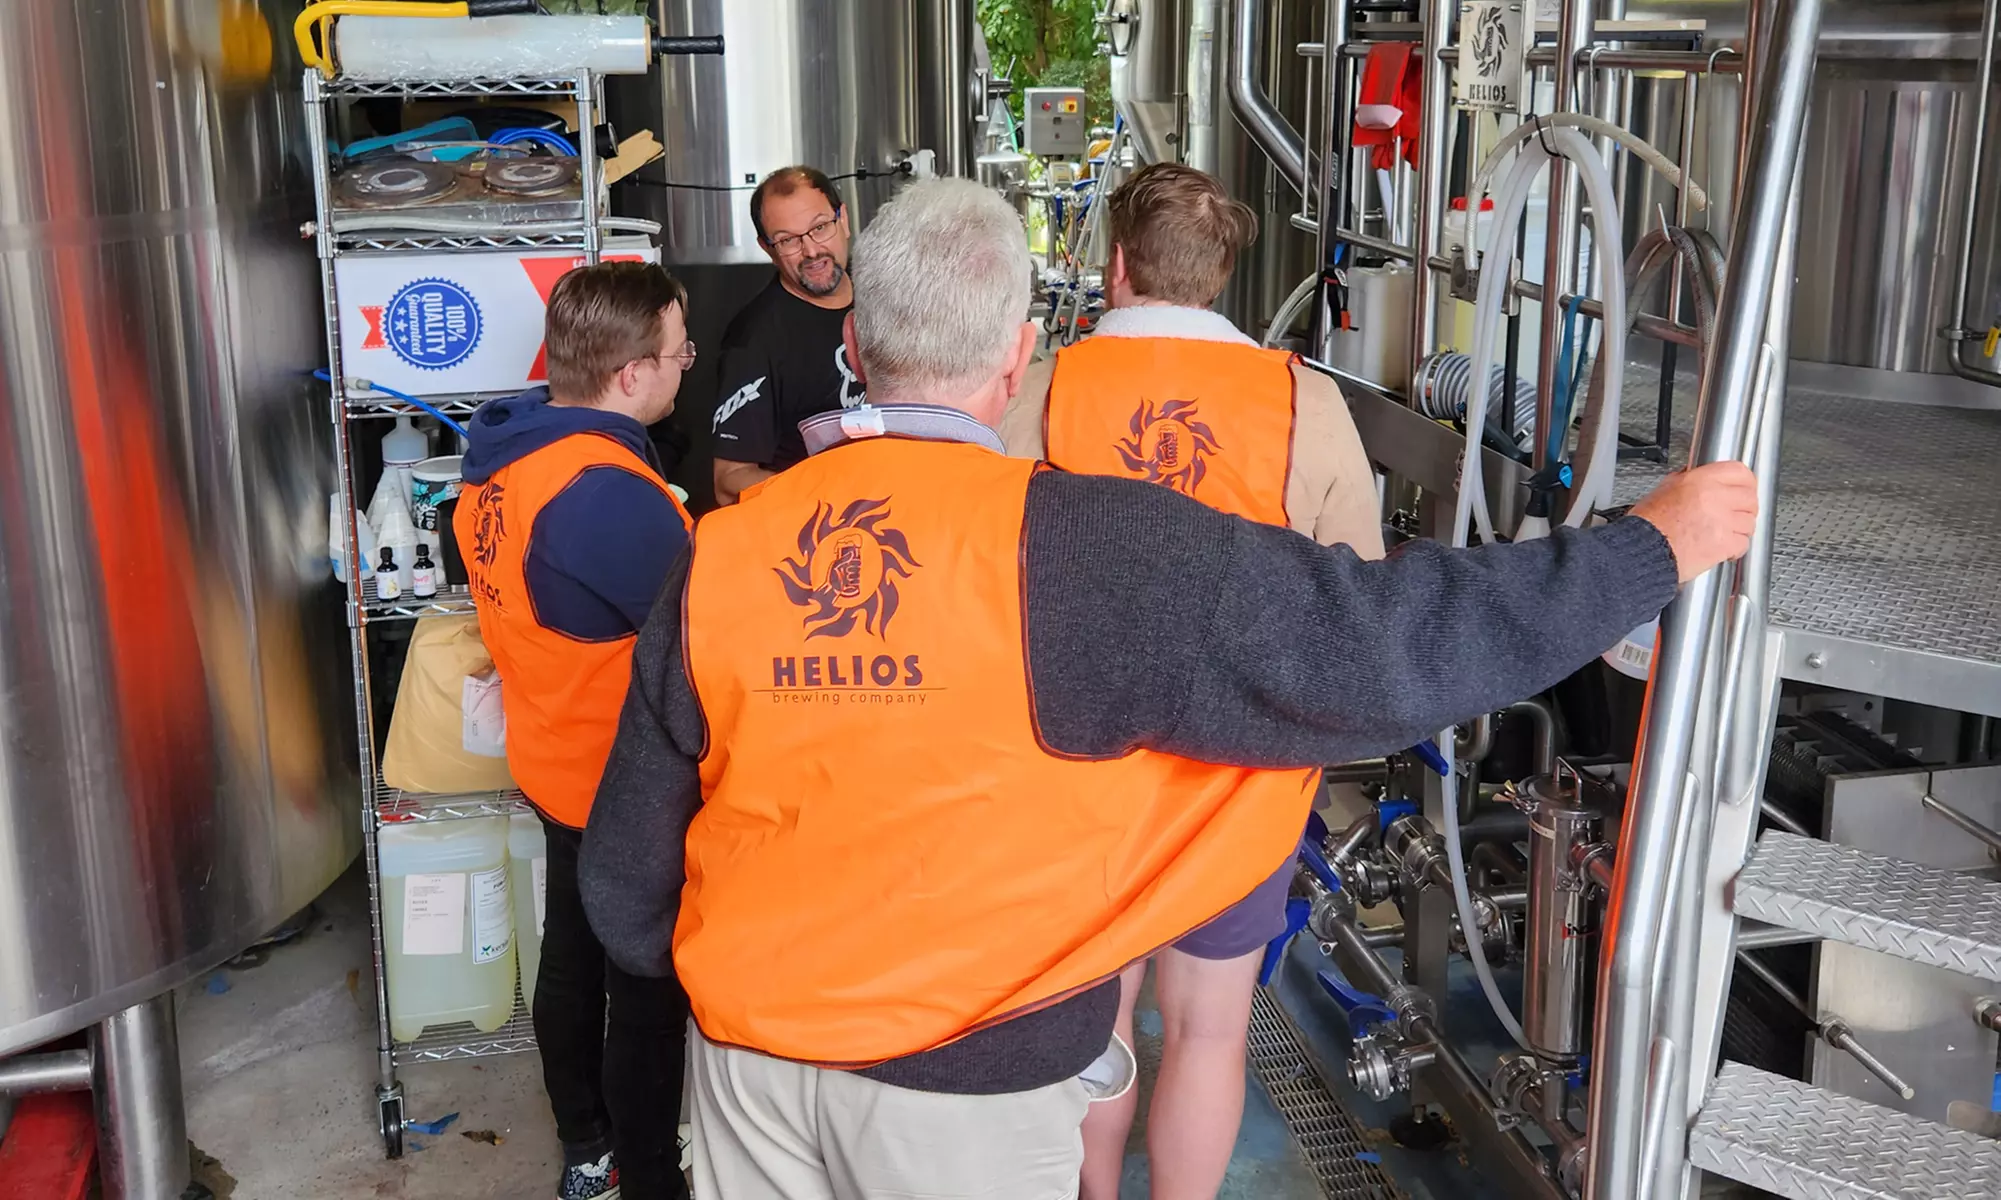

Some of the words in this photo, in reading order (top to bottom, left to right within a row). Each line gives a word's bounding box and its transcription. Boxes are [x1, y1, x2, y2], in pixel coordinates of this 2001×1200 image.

[1469, 84, 1507, 102] HELIOS
[404, 293, 424, 356] Guaranteed
[421, 292, 446, 355] QUALITY
[445, 304, 468, 342] 100%
[712, 376, 767, 434] FOX
[773, 654, 923, 687] HELIOS
[772, 692, 841, 705] brewing
[850, 693, 927, 706] company
